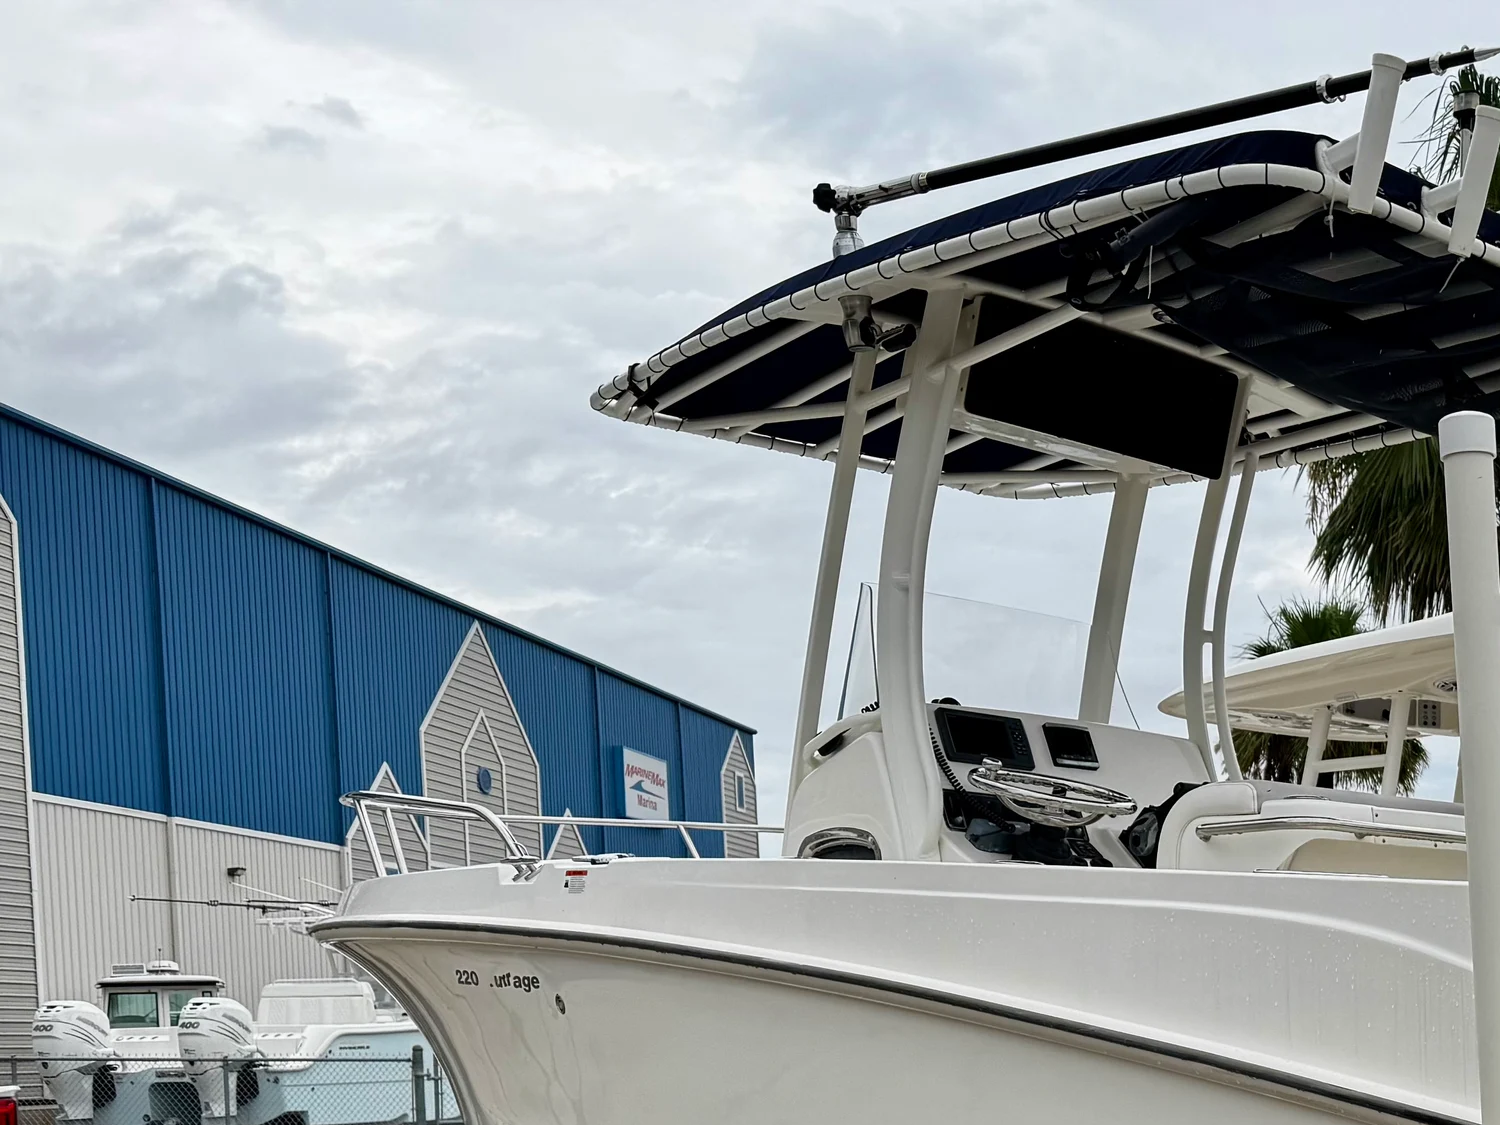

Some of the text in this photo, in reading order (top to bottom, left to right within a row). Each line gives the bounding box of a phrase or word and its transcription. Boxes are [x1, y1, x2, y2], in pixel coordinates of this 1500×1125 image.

[637, 793, 658, 811] Marina
[455, 969, 479, 986] 220
[33, 1024, 53, 1032] 400
[179, 1021, 200, 1029] 400
